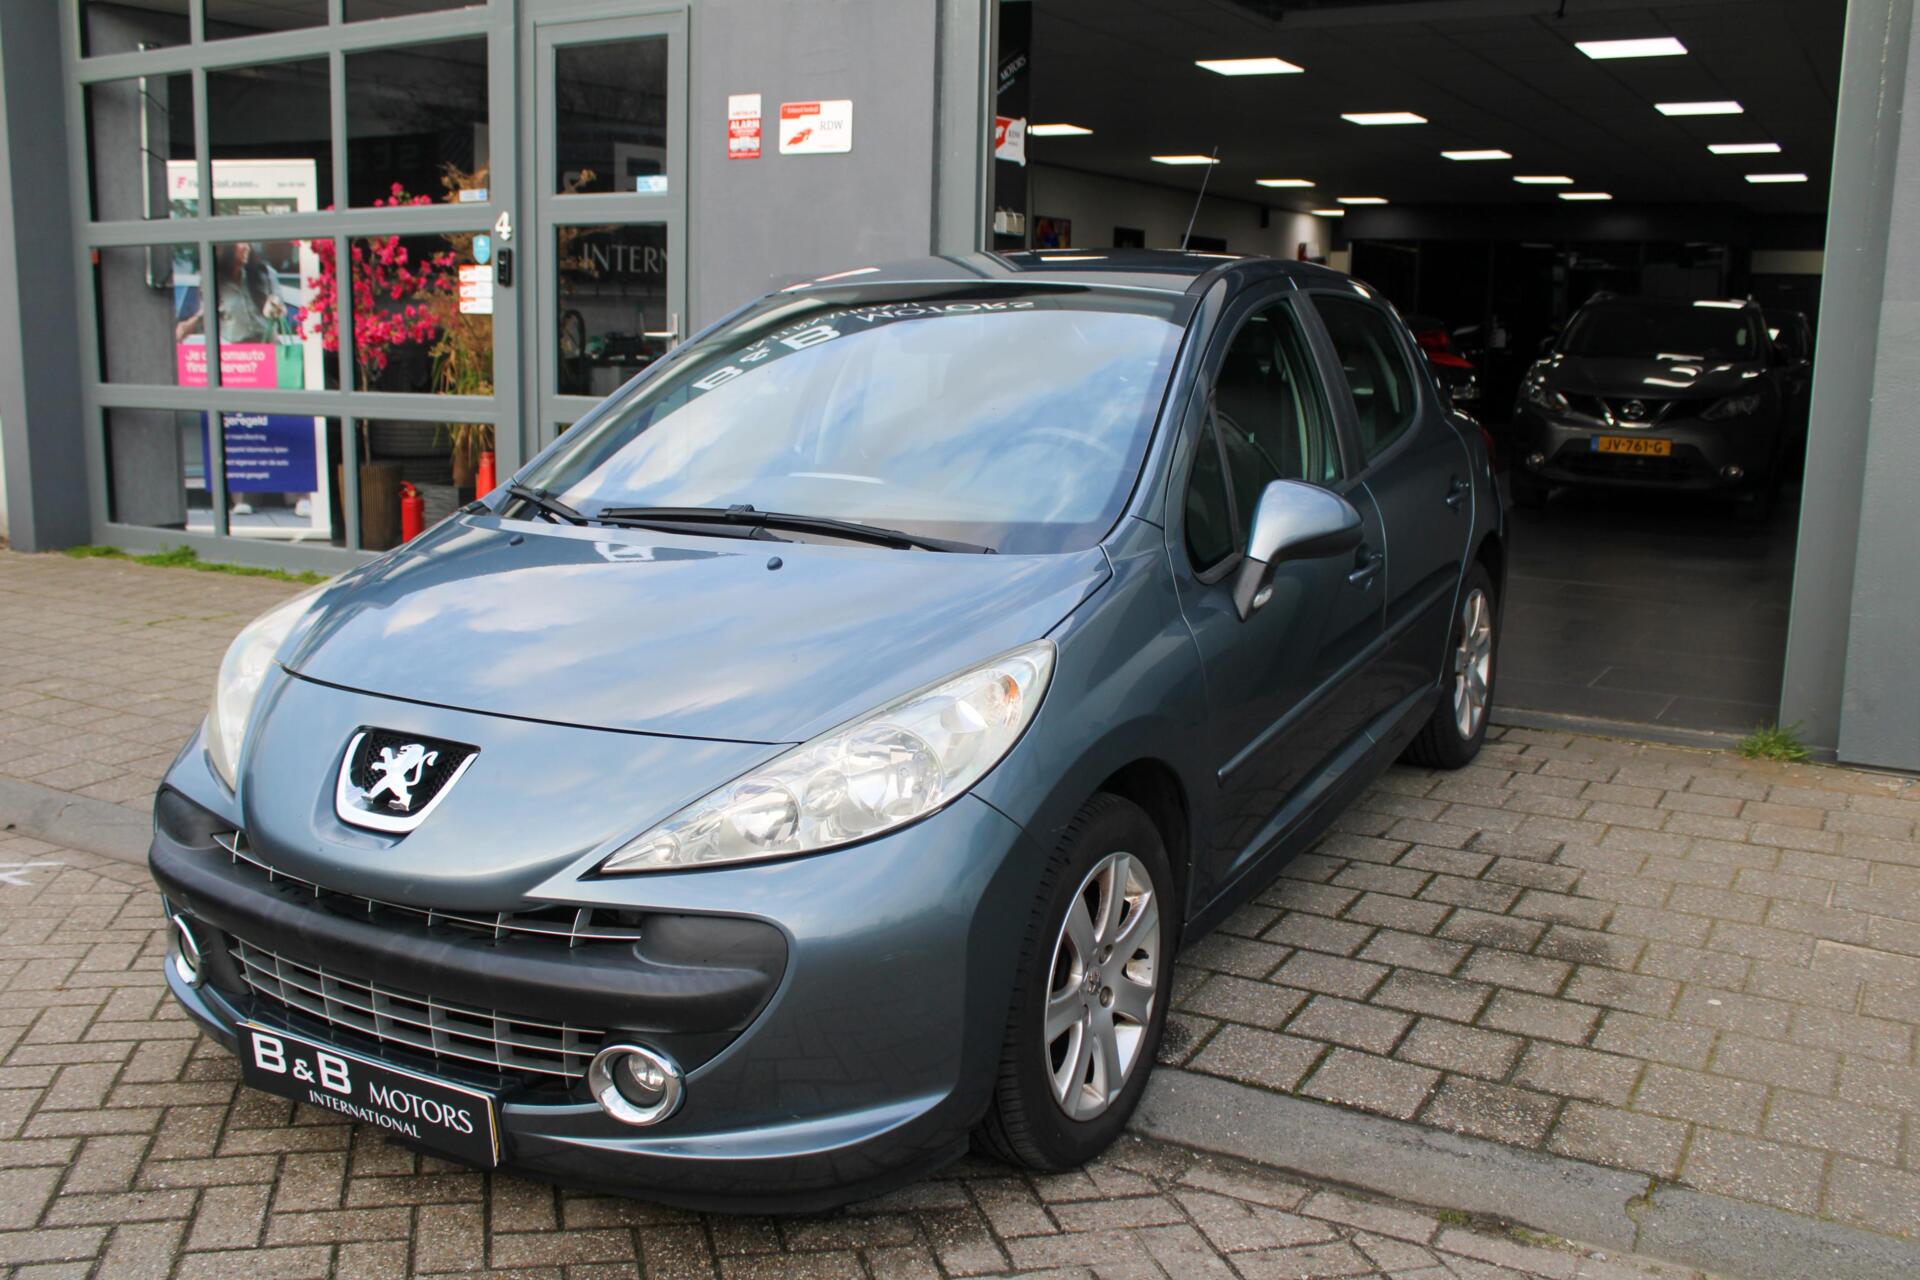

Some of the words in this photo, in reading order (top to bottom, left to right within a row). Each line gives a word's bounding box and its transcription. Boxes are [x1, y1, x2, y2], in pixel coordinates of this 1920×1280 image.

[730, 119, 760, 129] ALARM
[819, 120, 844, 131] RDW
[495, 211, 512, 240] 4
[1606, 438, 1663, 454] JV-761-G
[308, 1089, 422, 1139] INTERNATIONAL
[369, 1081, 474, 1134] MOTORS
